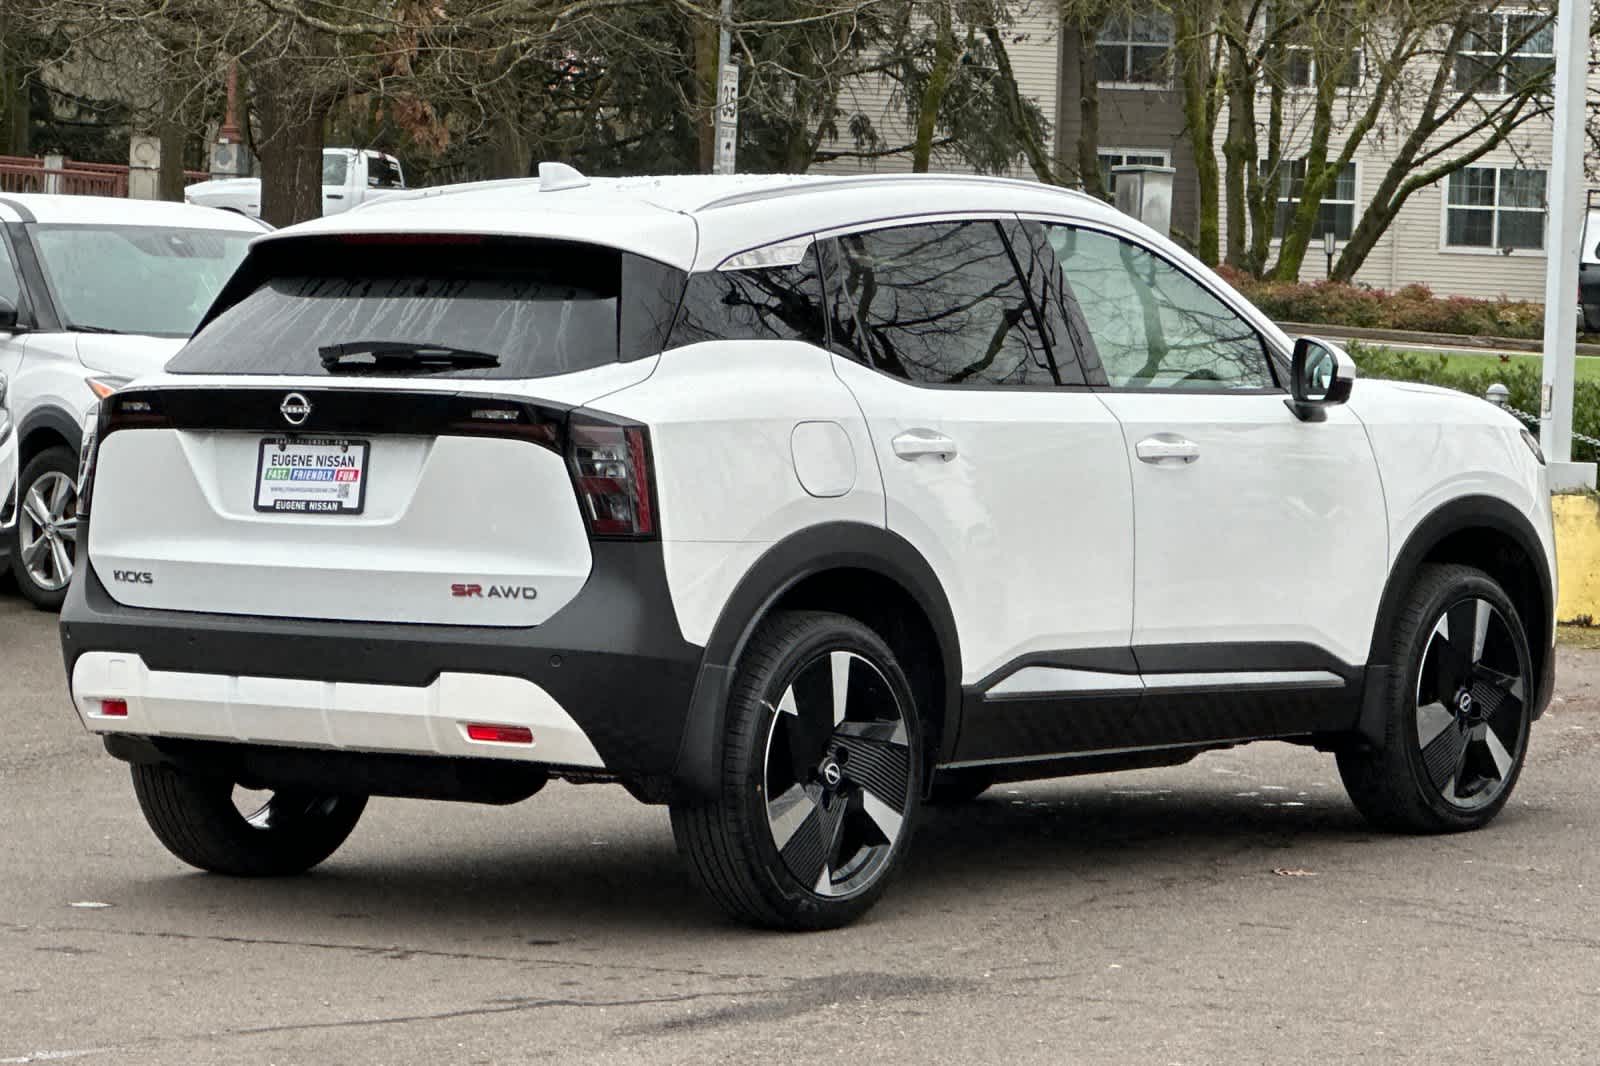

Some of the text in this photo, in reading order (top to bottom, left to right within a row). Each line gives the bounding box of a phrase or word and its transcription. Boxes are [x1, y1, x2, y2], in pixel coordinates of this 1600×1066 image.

[271, 454, 356, 468] EUGENE NISSAN
[267, 468, 357, 482] FAST. FRIENDLY. FUN.
[275, 500, 338, 511] EUGENE NISSAN
[113, 569, 153, 584] KICKS
[451, 583, 537, 600] SR AWD
